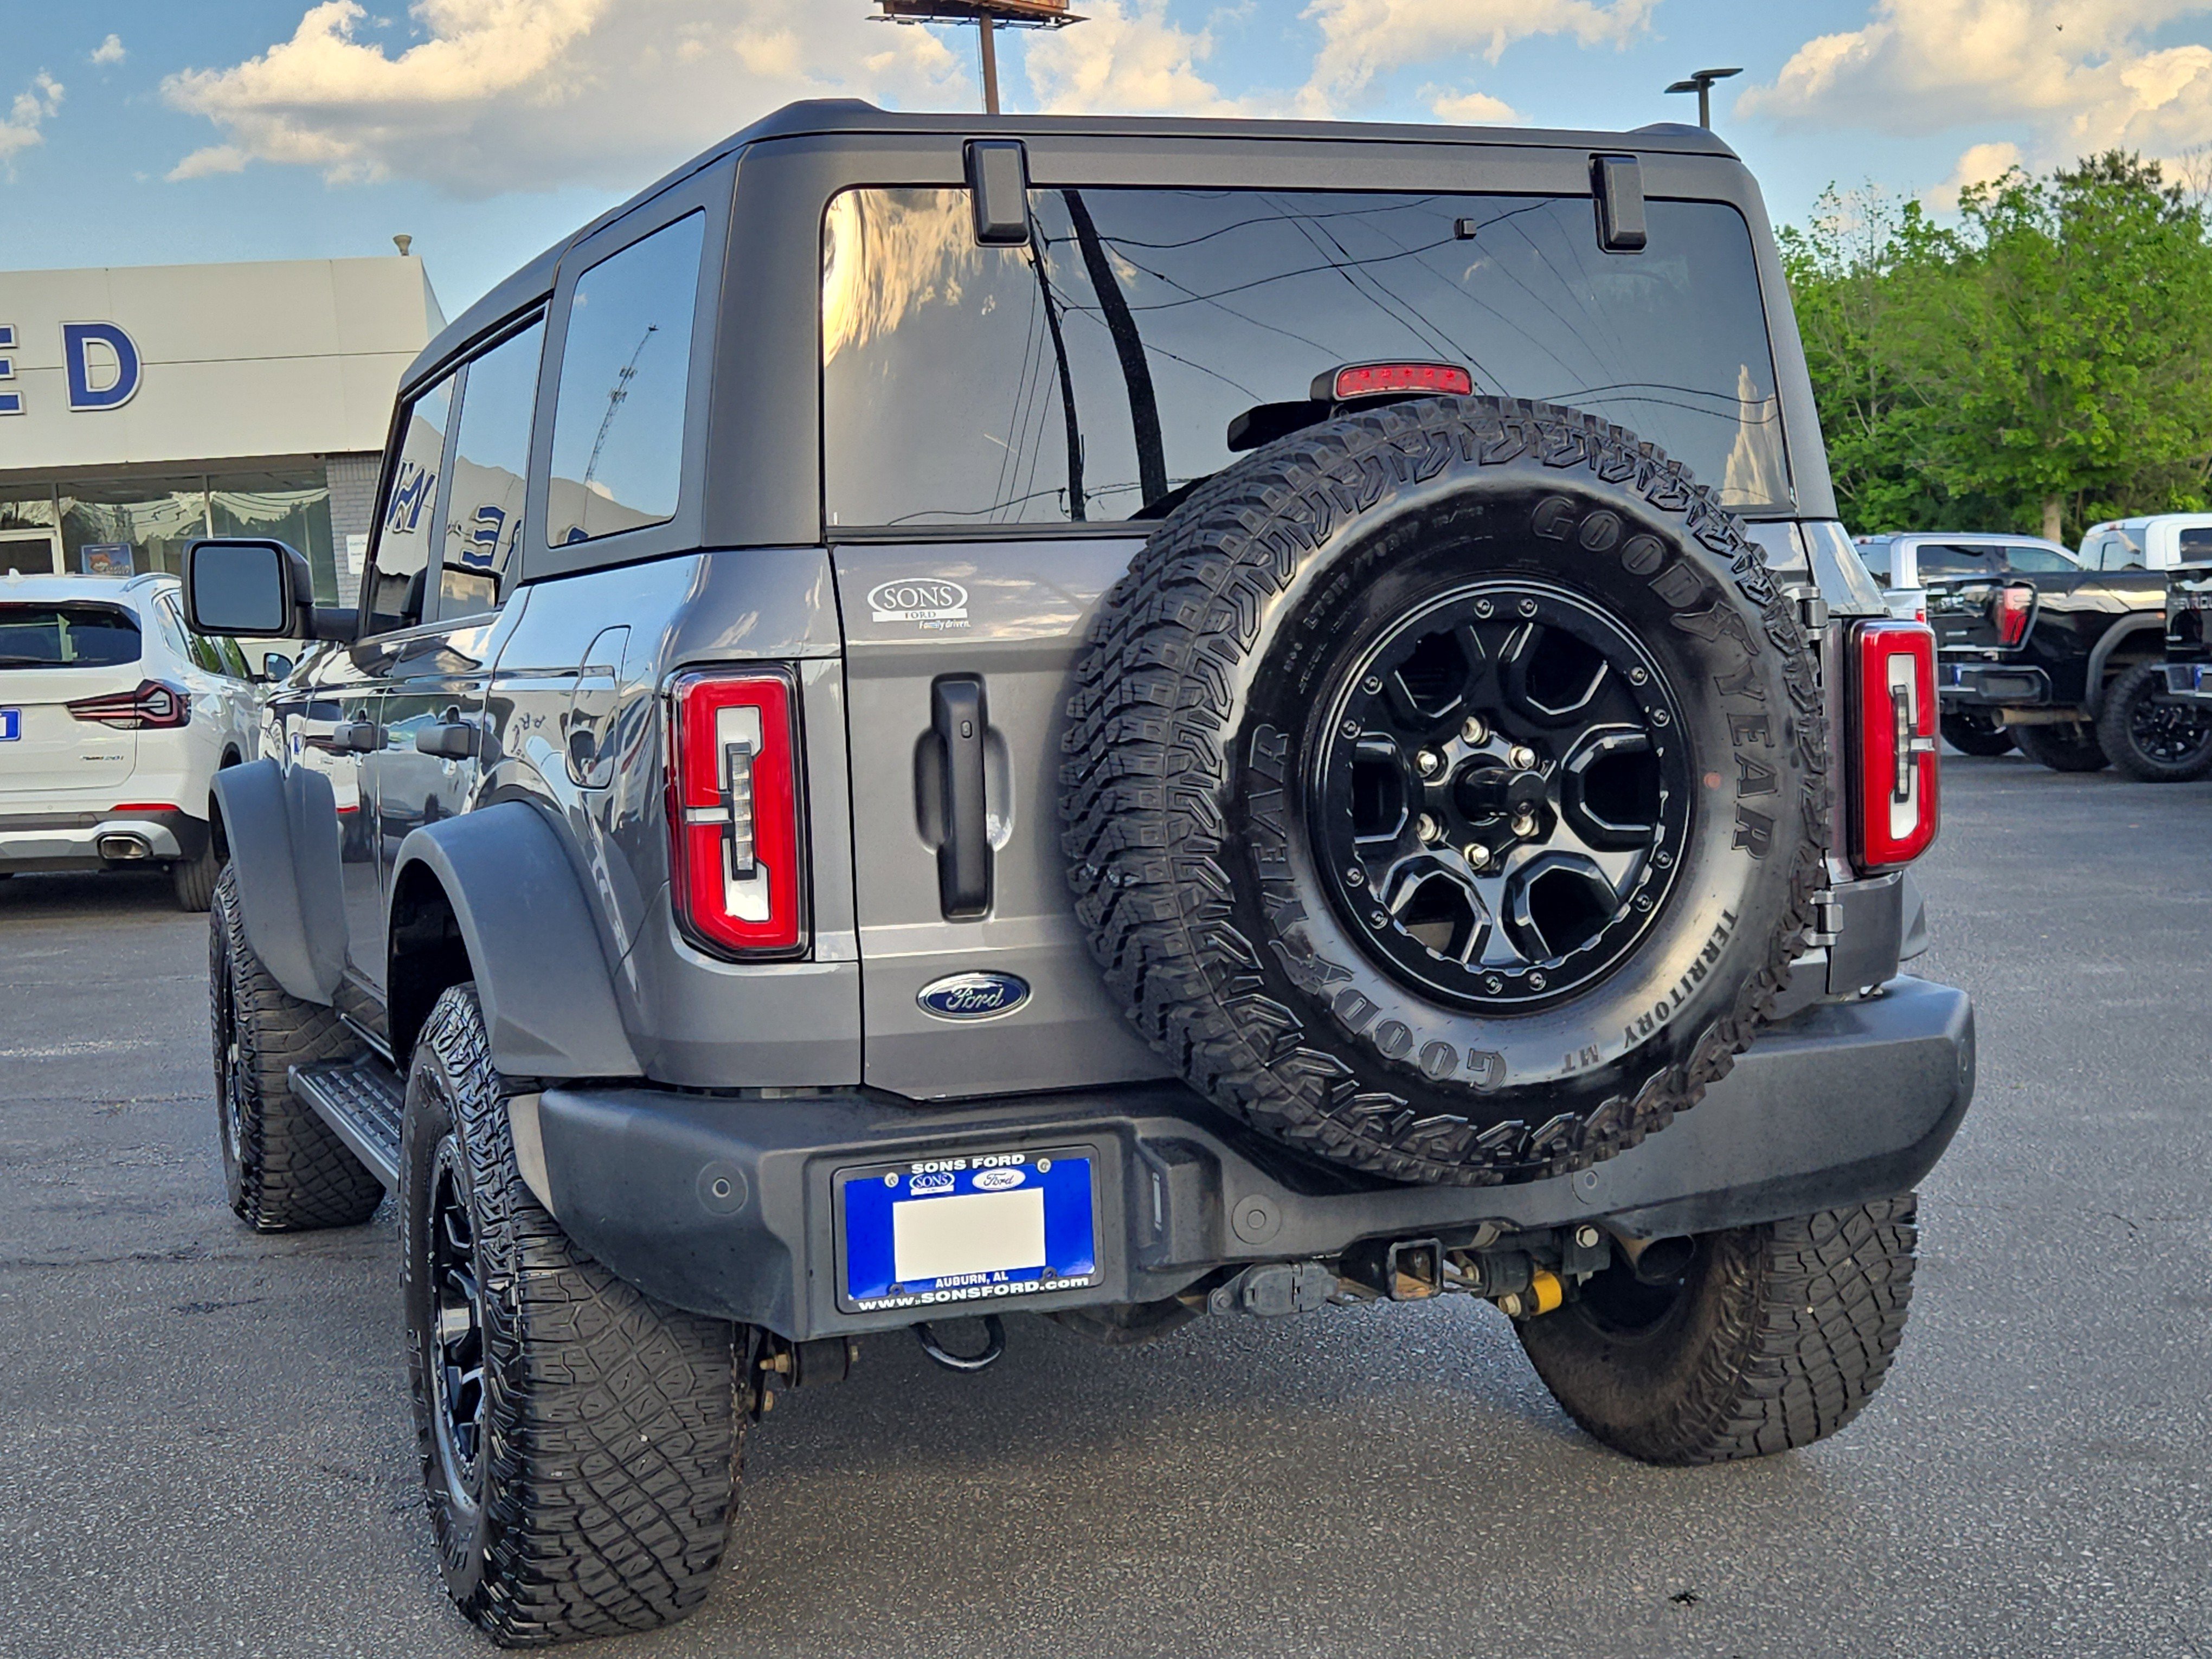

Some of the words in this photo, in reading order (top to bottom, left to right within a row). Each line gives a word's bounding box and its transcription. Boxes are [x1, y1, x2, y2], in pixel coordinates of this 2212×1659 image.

[884, 587, 953, 609] SONS
[1532, 496, 1780, 860] GOODYEAR
[1248, 723, 1508, 1093] GOODYEAR
[1624, 909, 1738, 1049] TERRITORY
[946, 983, 1004, 1011] Ford
[1561, 1044, 1599, 1075] MT
[911, 1159, 966, 1174] SONS
[972, 1154, 1025, 1169] FORD
[916, 1173, 949, 1188] SONS
[983, 1172, 1014, 1187] Ford
[859, 1276, 1090, 1311] www.SONSFORD.com
[935, 1274, 990, 1288] AUBURN,
[992, 1272, 1009, 1282] AL
